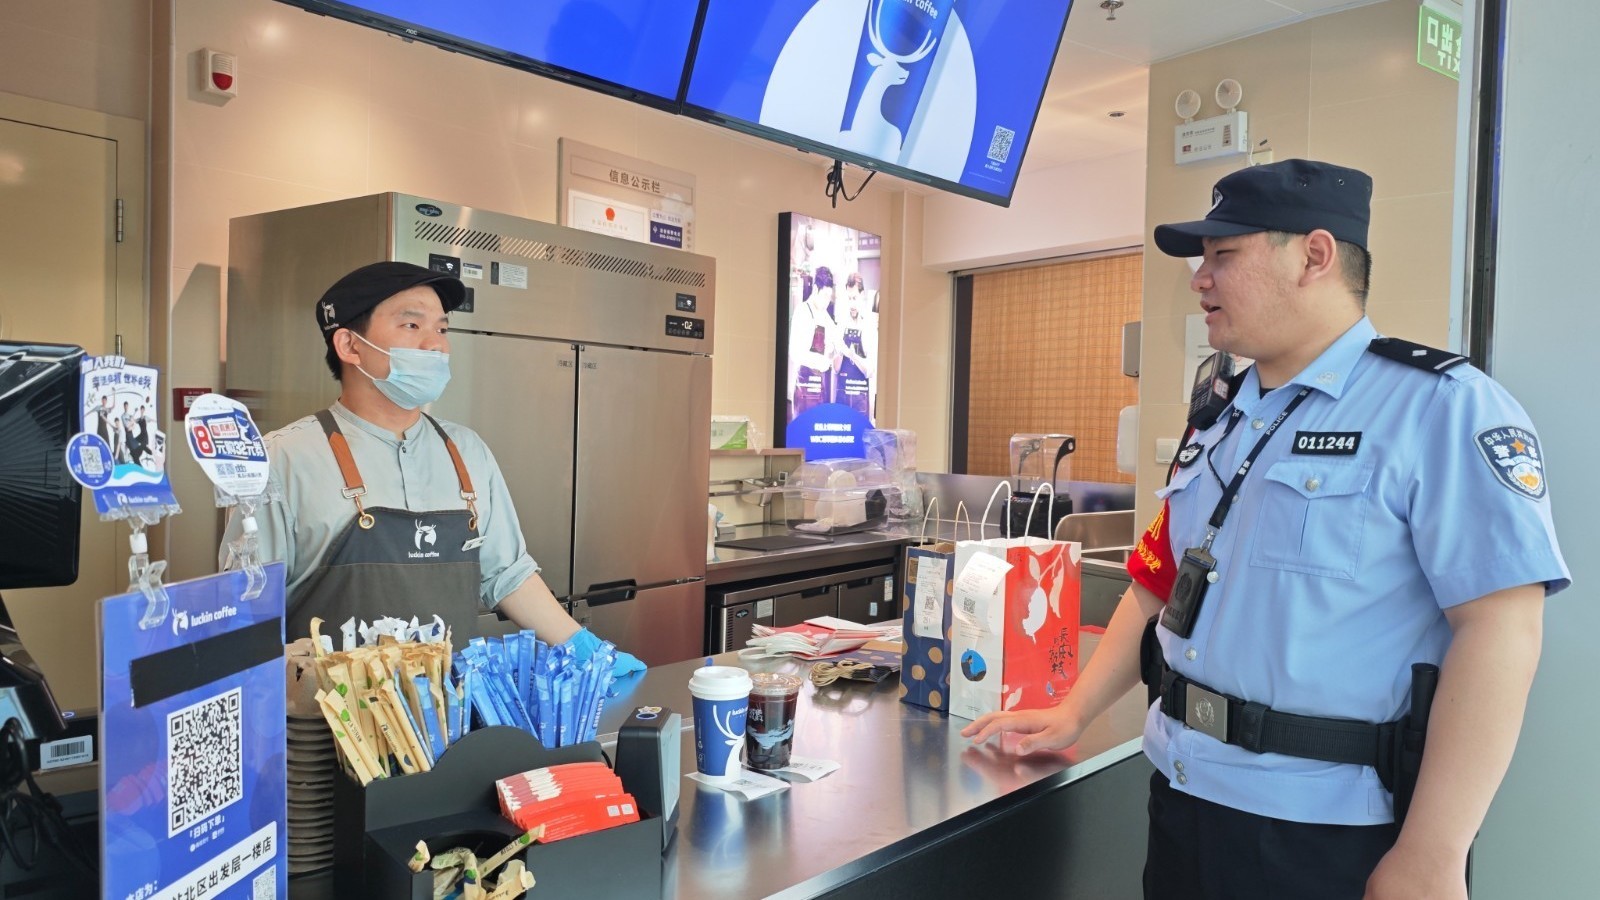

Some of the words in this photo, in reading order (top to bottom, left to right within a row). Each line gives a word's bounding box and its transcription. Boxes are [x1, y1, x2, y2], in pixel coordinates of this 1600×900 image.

[915, 0, 938, 19] coffee
[609, 169, 661, 193] 信息公示栏
[1266, 411, 1288, 436] POLICE
[193, 425, 214, 455] 8
[1298, 436, 1355, 450] 011244
[190, 611, 213, 627] luckin
[213, 605, 237, 620] coffee
